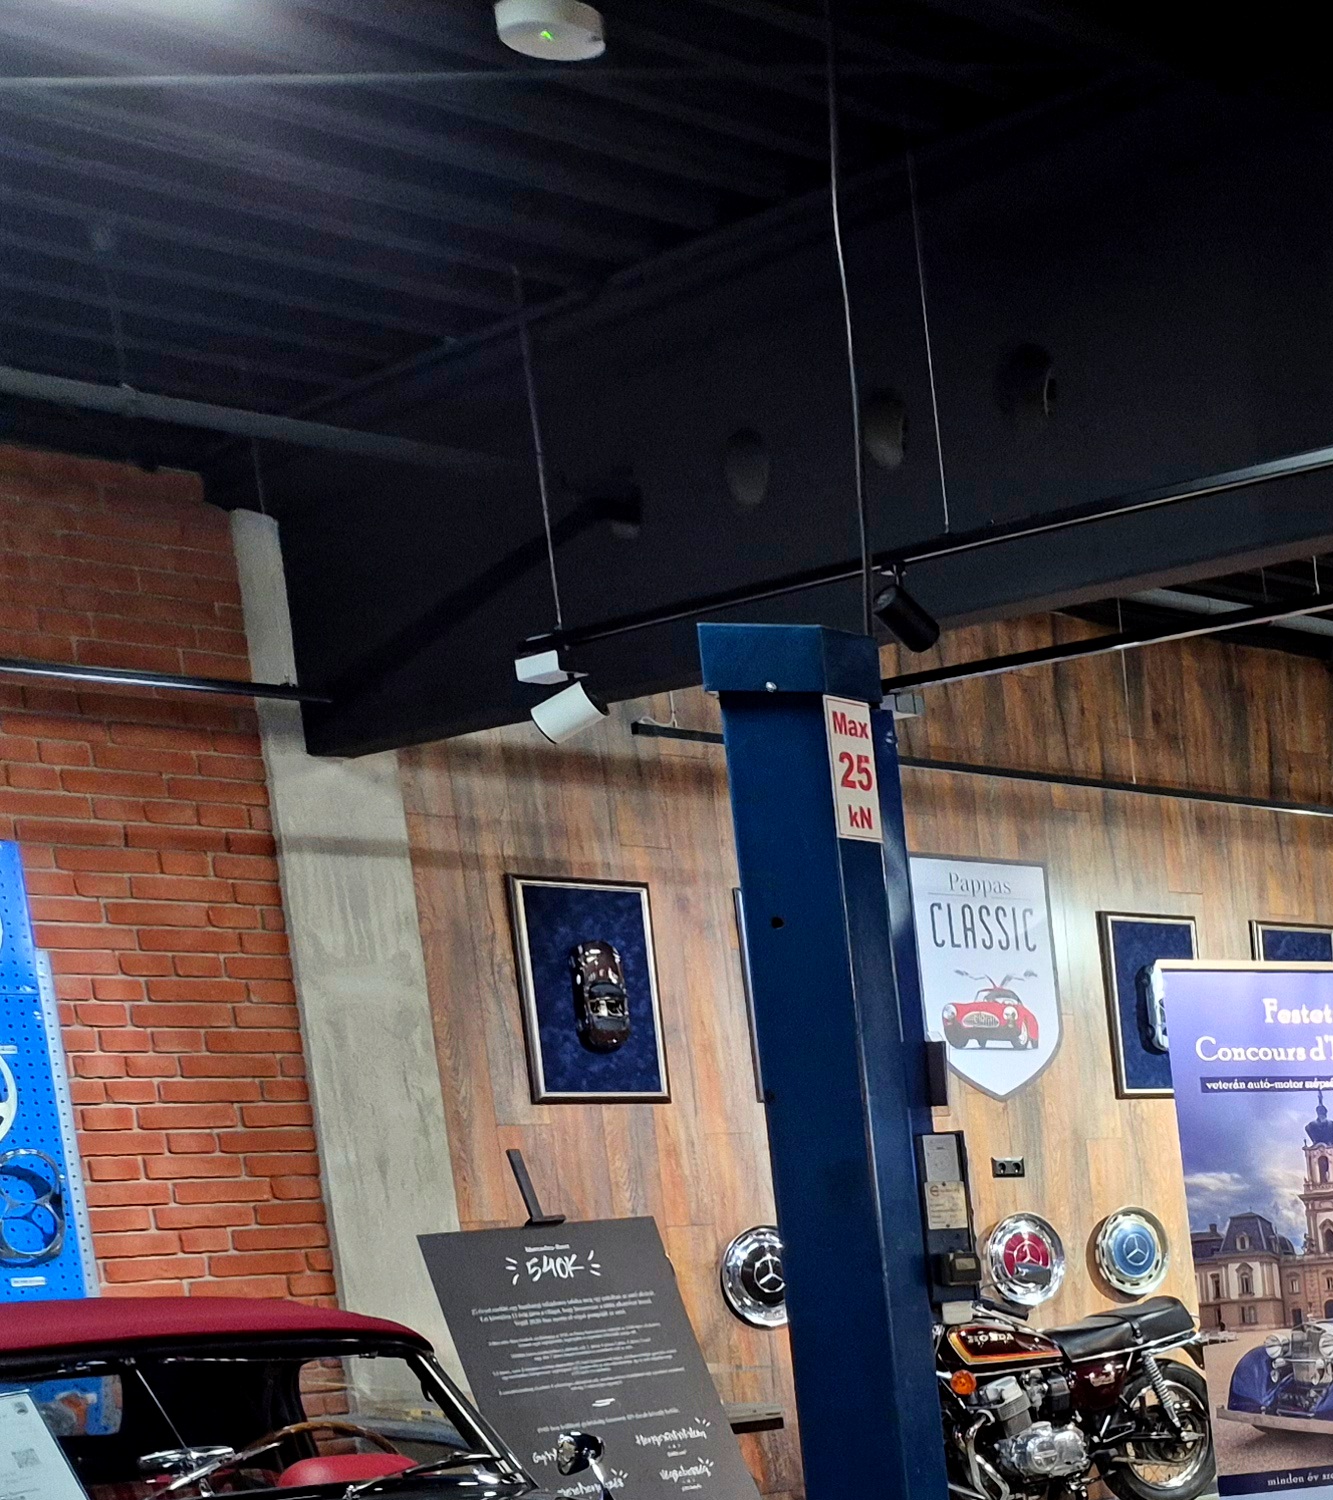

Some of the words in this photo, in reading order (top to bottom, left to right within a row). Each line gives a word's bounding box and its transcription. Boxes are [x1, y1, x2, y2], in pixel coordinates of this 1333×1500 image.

[832, 710, 869, 740] Max
[838, 751, 873, 792] 25
[848, 803, 873, 830] kN
[949, 872, 1012, 898] Pappas
[930, 902, 1037, 952] CLASSIC
[1195, 1035, 1307, 1062] Concours
[1206, 1079, 1246, 1091] veterán
[1247, 1078, 1304, 1090] autó-motor
[525, 1253, 585, 1283] 540K
[967, 1331, 1015, 1344] HONDA
[1267, 1474, 1304, 1487] minden
[1307, 1473, 1319, 1482] év
